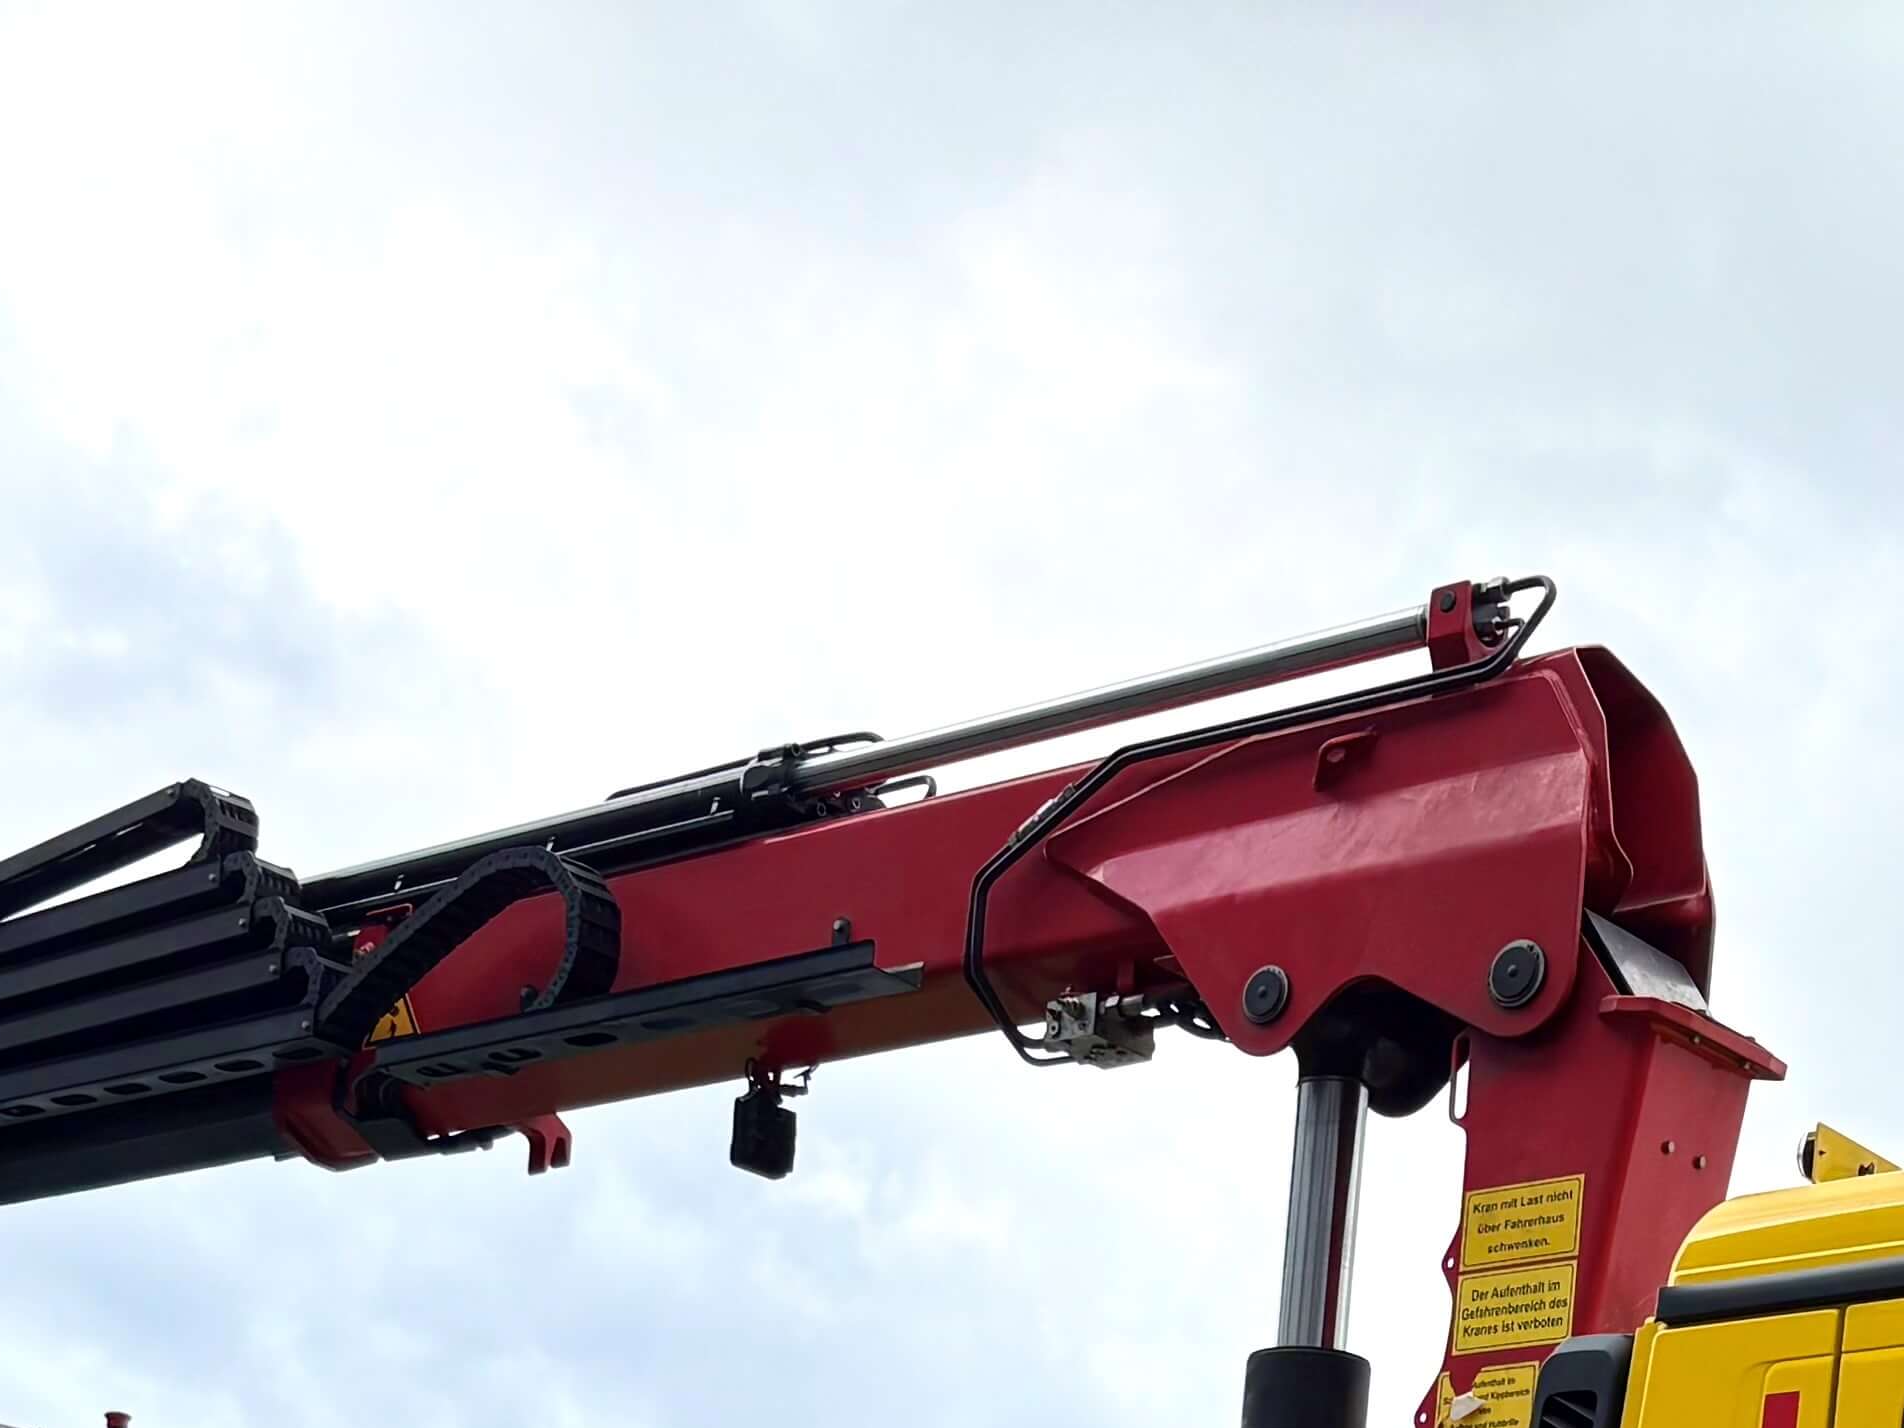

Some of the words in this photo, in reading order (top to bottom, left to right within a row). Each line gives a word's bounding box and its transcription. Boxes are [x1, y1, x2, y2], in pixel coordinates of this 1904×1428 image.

[1472, 1203, 1498, 1214] Kran
[1521, 1194, 1543, 1208] Last
[1546, 1189, 1573, 1202] nicht
[1477, 1221, 1500, 1235] über
[1504, 1213, 1565, 1230] Fahrerhaus
[1471, 1289, 1489, 1302] Der
[1491, 1281, 1545, 1299] Aufenthalt
[1547, 1280, 1561, 1291] im
[1462, 1299, 1546, 1321] Gefahrenbereich
[1548, 1298, 1568, 1309] des
[1462, 1323, 1498, 1338] Kranes
[1501, 1320, 1514, 1332] ist
[1517, 1316, 1563, 1330] verboten
